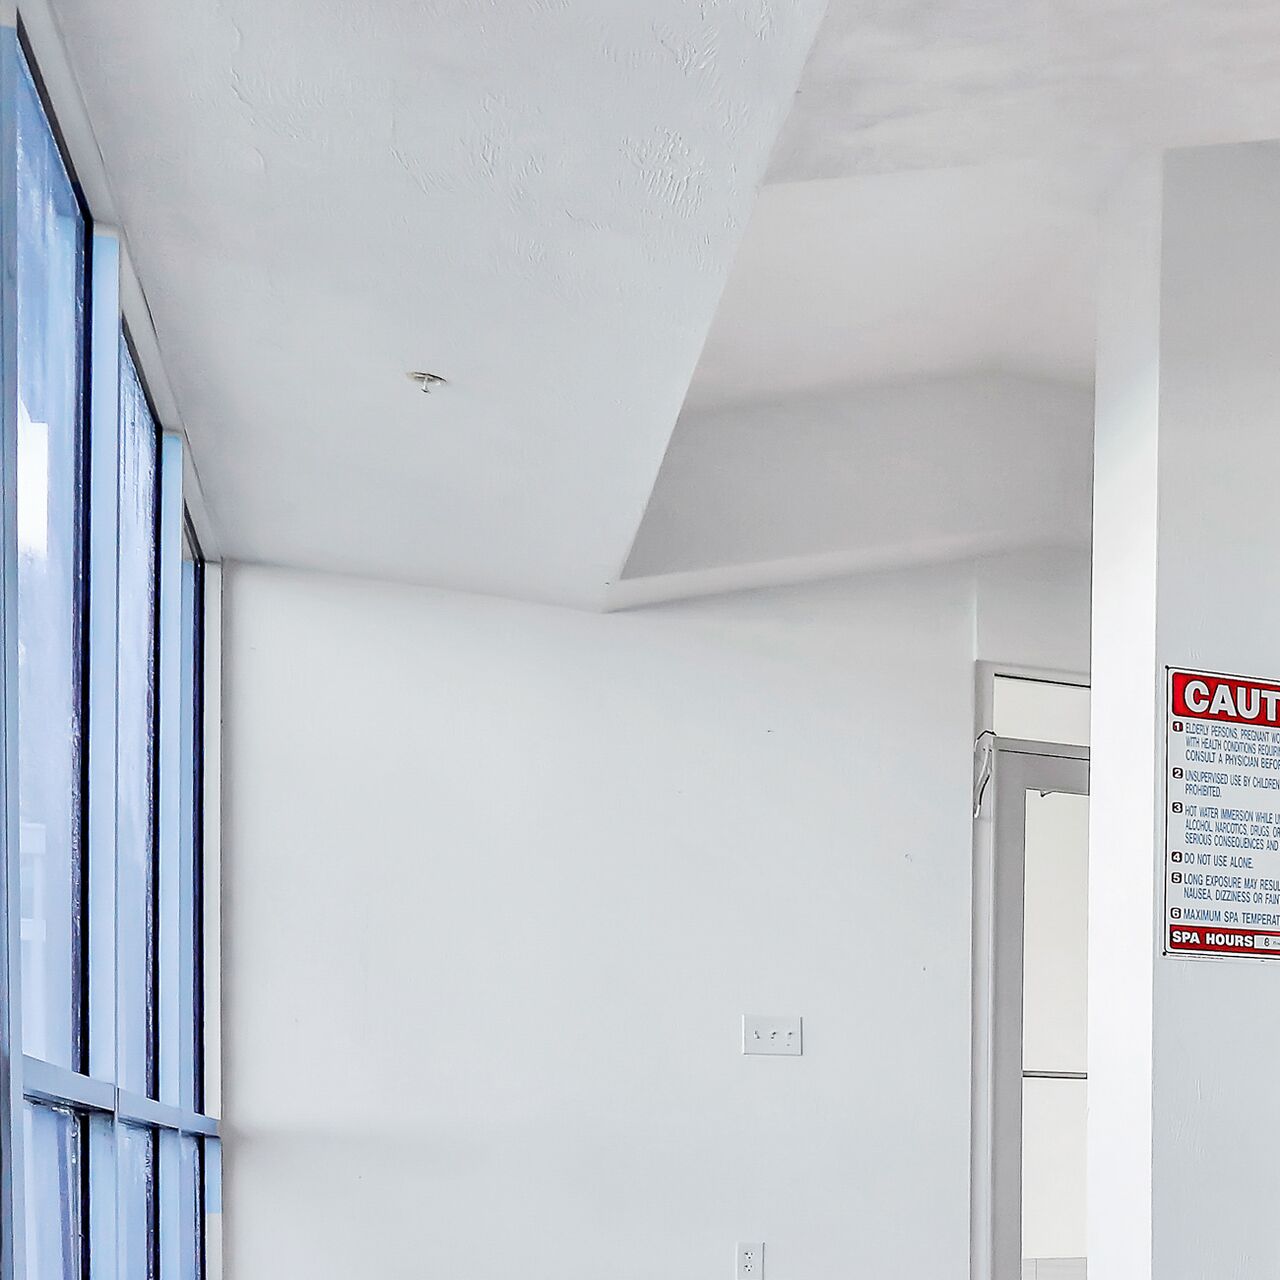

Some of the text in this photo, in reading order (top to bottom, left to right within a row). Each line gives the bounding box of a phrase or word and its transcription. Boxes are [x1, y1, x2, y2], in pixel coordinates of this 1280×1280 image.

[1173, 722, 1182, 732] 1
[1185, 722, 1209, 736] ELDERLY
[1241, 728, 1270, 742] PREGNANT
[1185, 736, 1200, 748] WITH
[1201, 738, 1221, 750] HEALTH
[1223, 740, 1256, 754] CONDITIONS
[1185, 749, 1216, 763] CONSULT
[1218, 753, 1223, 764] A
[1225, 753, 1259, 768] PHYSICIAN
[1173, 768, 1182, 778] 2
[1185, 769, 1228, 785] UNSUPERVISED
[1230, 774, 1241, 786] USE
[1243, 775, 1252, 787] BY
[1252, 776, 1280, 790] CHILDREN
[1173, 802, 1182, 812] 3
[1184, 805, 1197, 817] HOT
[1199, 806, 1219, 819] WATER
[1221, 808, 1254, 822] IMMERSION
[1254, 811, 1273, 824] WHILE
[1272, 826, 1280, 838] OR
[1184, 832, 1212, 846] SERIOUS
[1213, 834, 1264, 850] CONSEQUENCES
[1266, 839, 1279, 851] AND
[1172, 853, 1181, 862] 4
[1184, 852, 1195, 865] DO
[1197, 853, 1211, 866] NOT
[1213, 854, 1228, 867] USE
[1172, 873, 1181, 882] 5
[1183, 872, 1203, 886] LONG
[1205, 874, 1242, 889] EXPOSURE
[1243, 877, 1258, 890] MAY
[1215, 889, 1251, 903] DIZZINESS
[1252, 891, 1263, 904] OR
[1172, 908, 1181, 918] 6
[1183, 908, 1221, 922] MAXIMUM
[1223, 910, 1239, 923] SPA
[1172, 930, 1200, 944] SPA
[1205, 933, 1254, 947] HOURS
